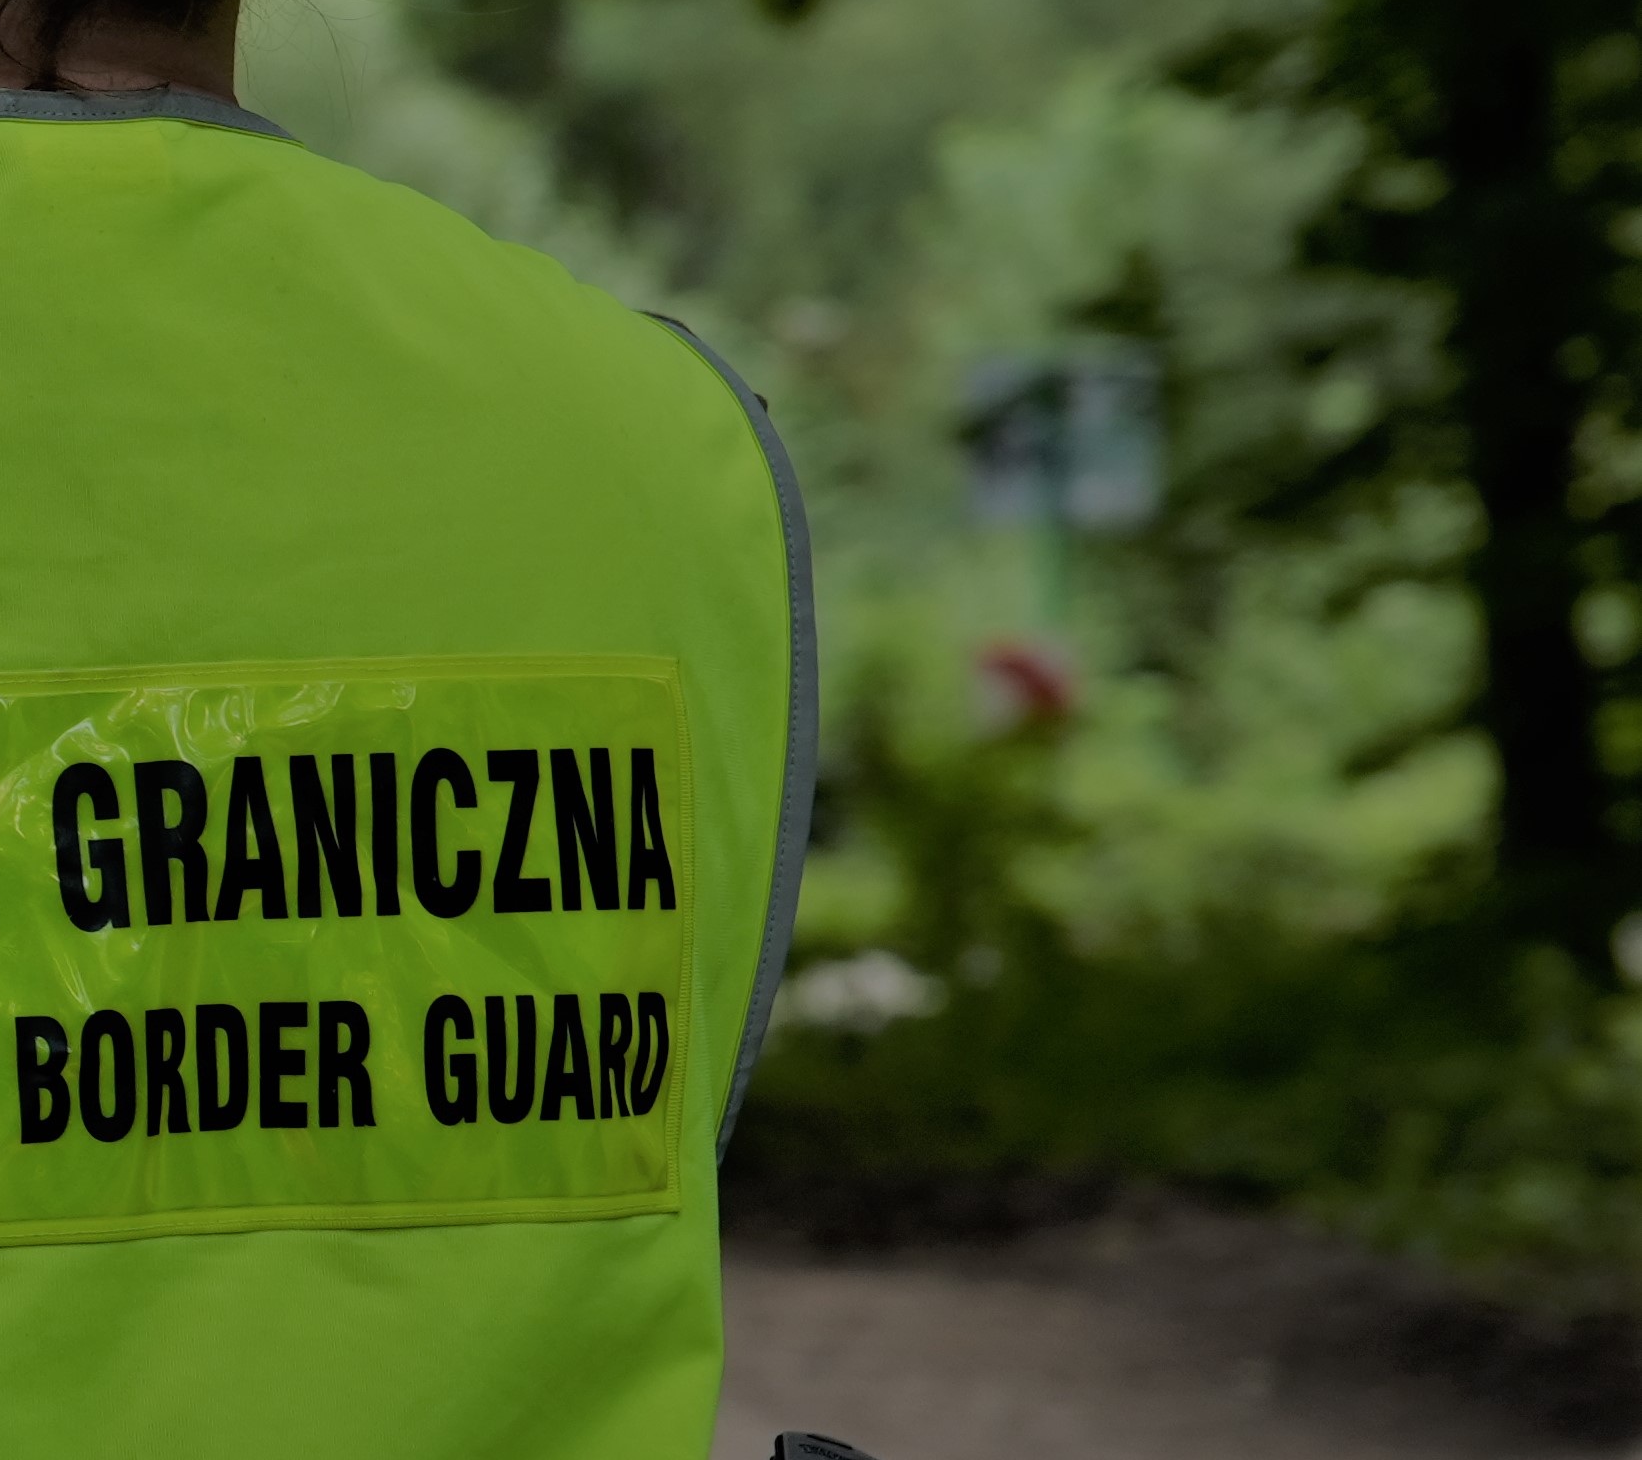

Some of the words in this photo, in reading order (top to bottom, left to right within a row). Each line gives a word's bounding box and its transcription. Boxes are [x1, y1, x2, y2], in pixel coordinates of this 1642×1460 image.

[51, 747, 678, 933] GRANICZNA
[13, 997, 376, 1145] BORDER
[421, 991, 671, 1126] GUARD
